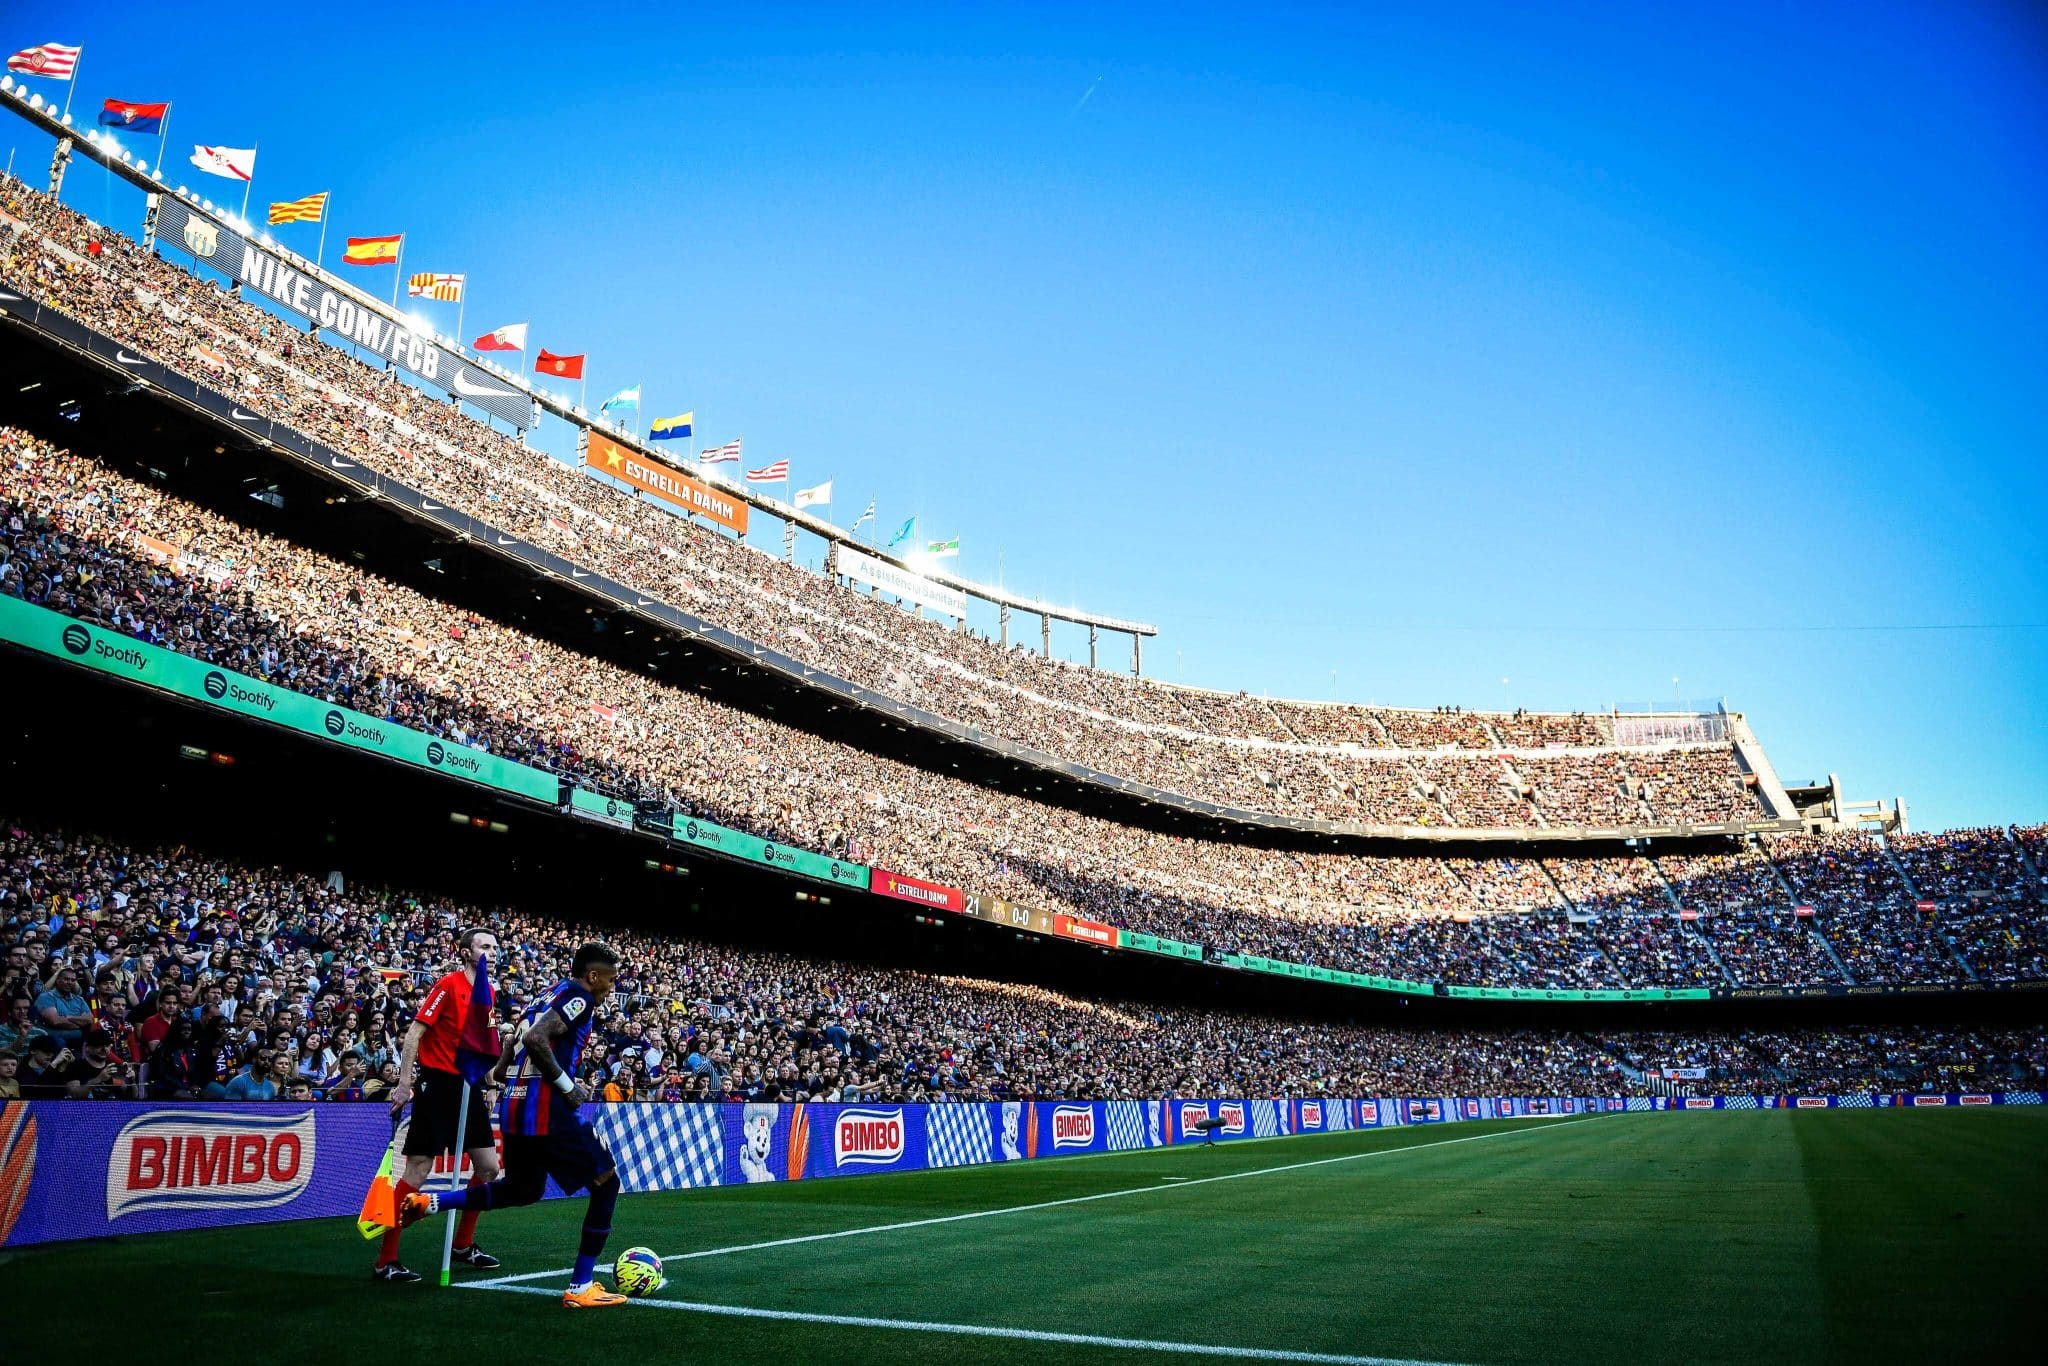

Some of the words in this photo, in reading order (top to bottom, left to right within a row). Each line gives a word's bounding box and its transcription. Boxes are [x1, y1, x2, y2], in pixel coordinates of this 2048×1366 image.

[240, 246, 439, 379] NIKE.COM/FCB
[625, 460, 690, 501] ESTRELLA
[692, 490, 733, 520] DAMM
[95, 640, 147, 670] Spotify
[230, 685, 276, 711] Spotify
[347, 722, 386, 745] Spotify
[446, 752, 480, 773] Spotify
[699, 829, 721, 844] Spotify
[775, 851, 796, 864] Spotify
[840, 868, 859, 882] Spotify
[898, 883, 928, 902] ESTRELLA
[929, 893, 948, 906] DAMM
[965, 894, 980, 915] 21
[1012, 907, 1029, 925] 0-0
[1916, 1097, 1944, 1105] BIMBO
[1962, 1096, 1990, 1104] BIMBO
[1183, 1110, 1207, 1128] BIMBO
[1303, 1108, 1320, 1123] BIMBO
[840, 1121, 900, 1152] BIMBO
[1055, 1114, 1092, 1139] BIMBO
[127, 1132, 302, 1191] BIMBO
